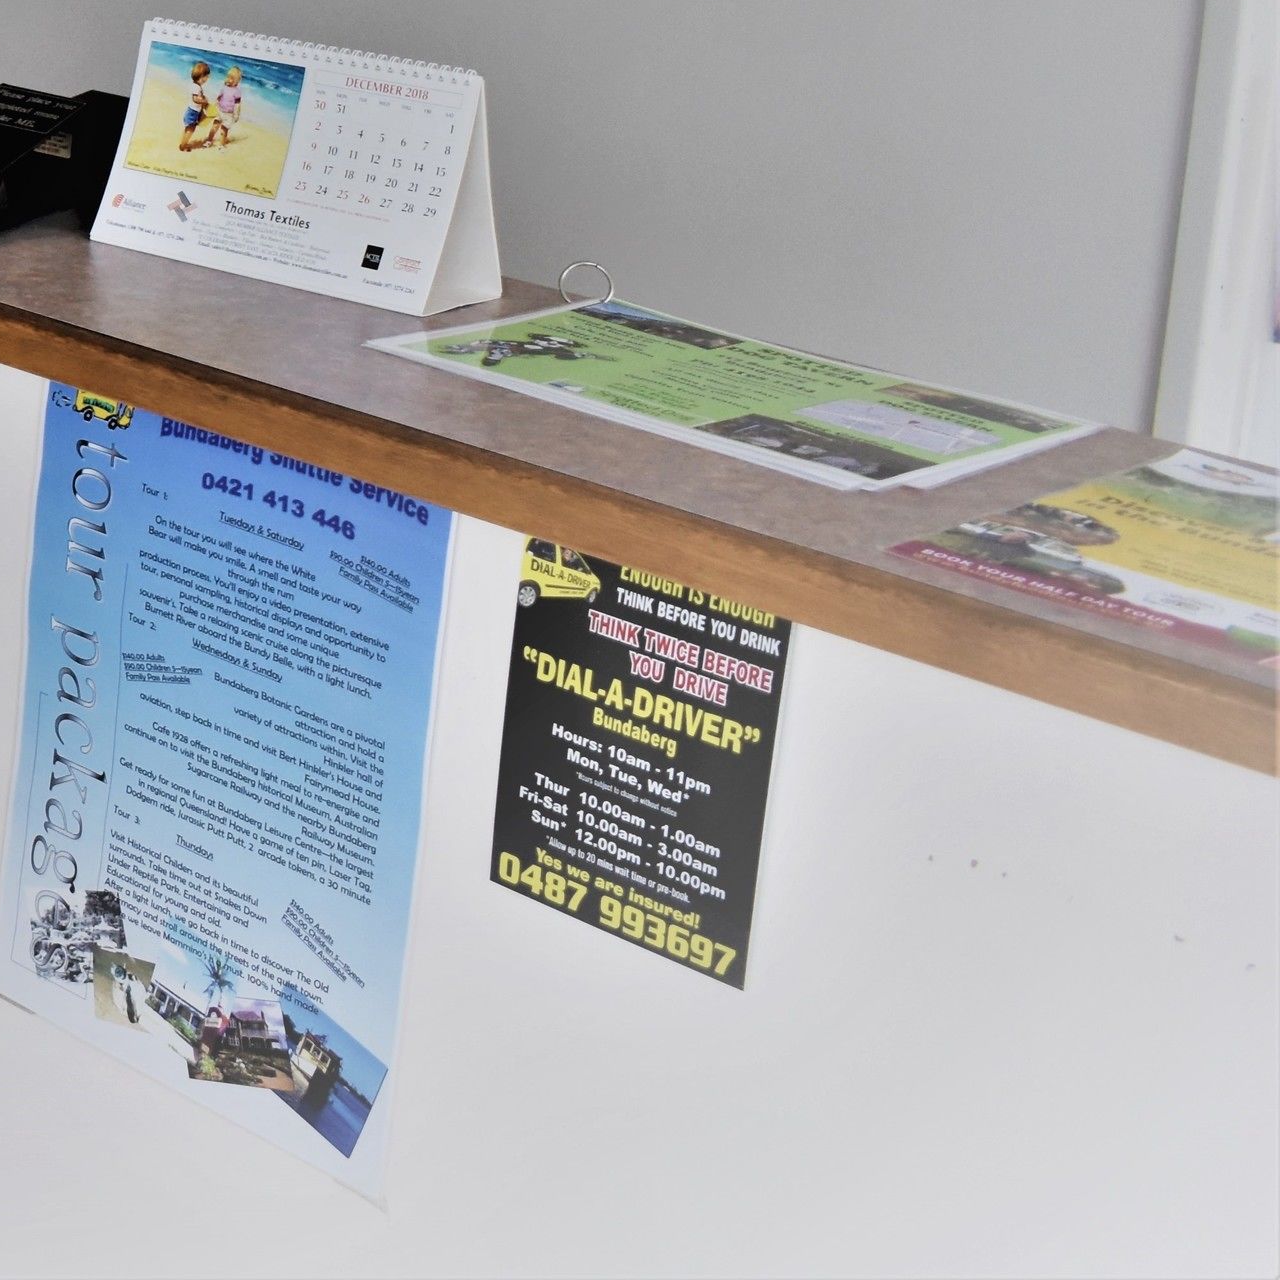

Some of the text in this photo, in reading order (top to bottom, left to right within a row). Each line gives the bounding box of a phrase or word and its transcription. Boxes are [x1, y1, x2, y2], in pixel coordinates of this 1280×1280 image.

[345, 76, 430, 101] DECEMBER 2018
[310, 142, 318, 151] 9
[327, 145, 339, 157] 10
[348, 149, 359, 160] 11
[369, 153, 382, 165] 12
[413, 161, 425, 173] 14
[435, 166, 446, 177] 15
[323, 165, 334, 176] 17
[344, 169, 355, 181] 18
[365, 173, 377, 184] 19
[384, 177, 399, 189] 20
[407, 181, 419, 193] 21
[427, 186, 443, 198] 22
[224, 199, 267, 220] Thomas
[269, 209, 311, 230] Textiles
[142, 482, 160, 497] Tour
[159, 416, 265, 466] Bundaberg
[348, 477, 429, 526] Service
[201, 471, 356, 541] 0421 413 446
[65, 437, 129, 602] tour
[154, 514, 316, 582] On the tour you will see where the White
[616, 586, 782, 657] THINK BEFORE YOU DRINK
[620, 566, 776, 629] ENOUGH IS ENOUGH
[920, 548, 1175, 627] BOOK YOUR HALF DAY TOUR
[587, 608, 775, 694] THINK TWICE BEFORE
[628, 649, 729, 707] YOU DRIVE
[213, 671, 260, 700] Bundaberg
[260, 690, 293, 712] Botanic
[293, 704, 329, 727] Gardens
[330, 721, 345, 734] are
[354, 732, 386, 751] pivotal
[592, 706, 677, 758] Bundaberg
[551, 722, 603, 754] Hours:
[607, 744, 651, 772] 10am
[666, 767, 711, 795] 11pm
[566, 747, 604, 776] Mon,
[608, 763, 643, 791] Tue,
[534, 771, 571, 797] Thur
[579, 791, 646, 829] 10.00am
[660, 824, 721, 859] 1.00am
[593, 779, 613, 792] subject
[619, 790, 639, 803] change
[639, 798, 660, 811] without
[519, 785, 569, 817] Fri-Sat
[576, 809, 643, 847] 10.00am
[657, 841, 718, 877] 3.00am
[575, 828, 641, 866] 12.00pm
[656, 861, 726, 900] 10.00pm
[110, 828, 259, 908] Visit Historical Childers and its beautiful
[536, 846, 701, 930] Yes we are insured!
[567, 846, 577, 857] up
[577, 848, 586, 860] to
[585, 851, 596, 864] 20
[596, 858, 614, 872] mins
[614, 865, 630, 879] wait
[630, 870, 647, 886] time
[647, 879, 657, 889] or
[656, 883, 691, 904] pre-book.
[498, 851, 737, 976] 0487 993697
